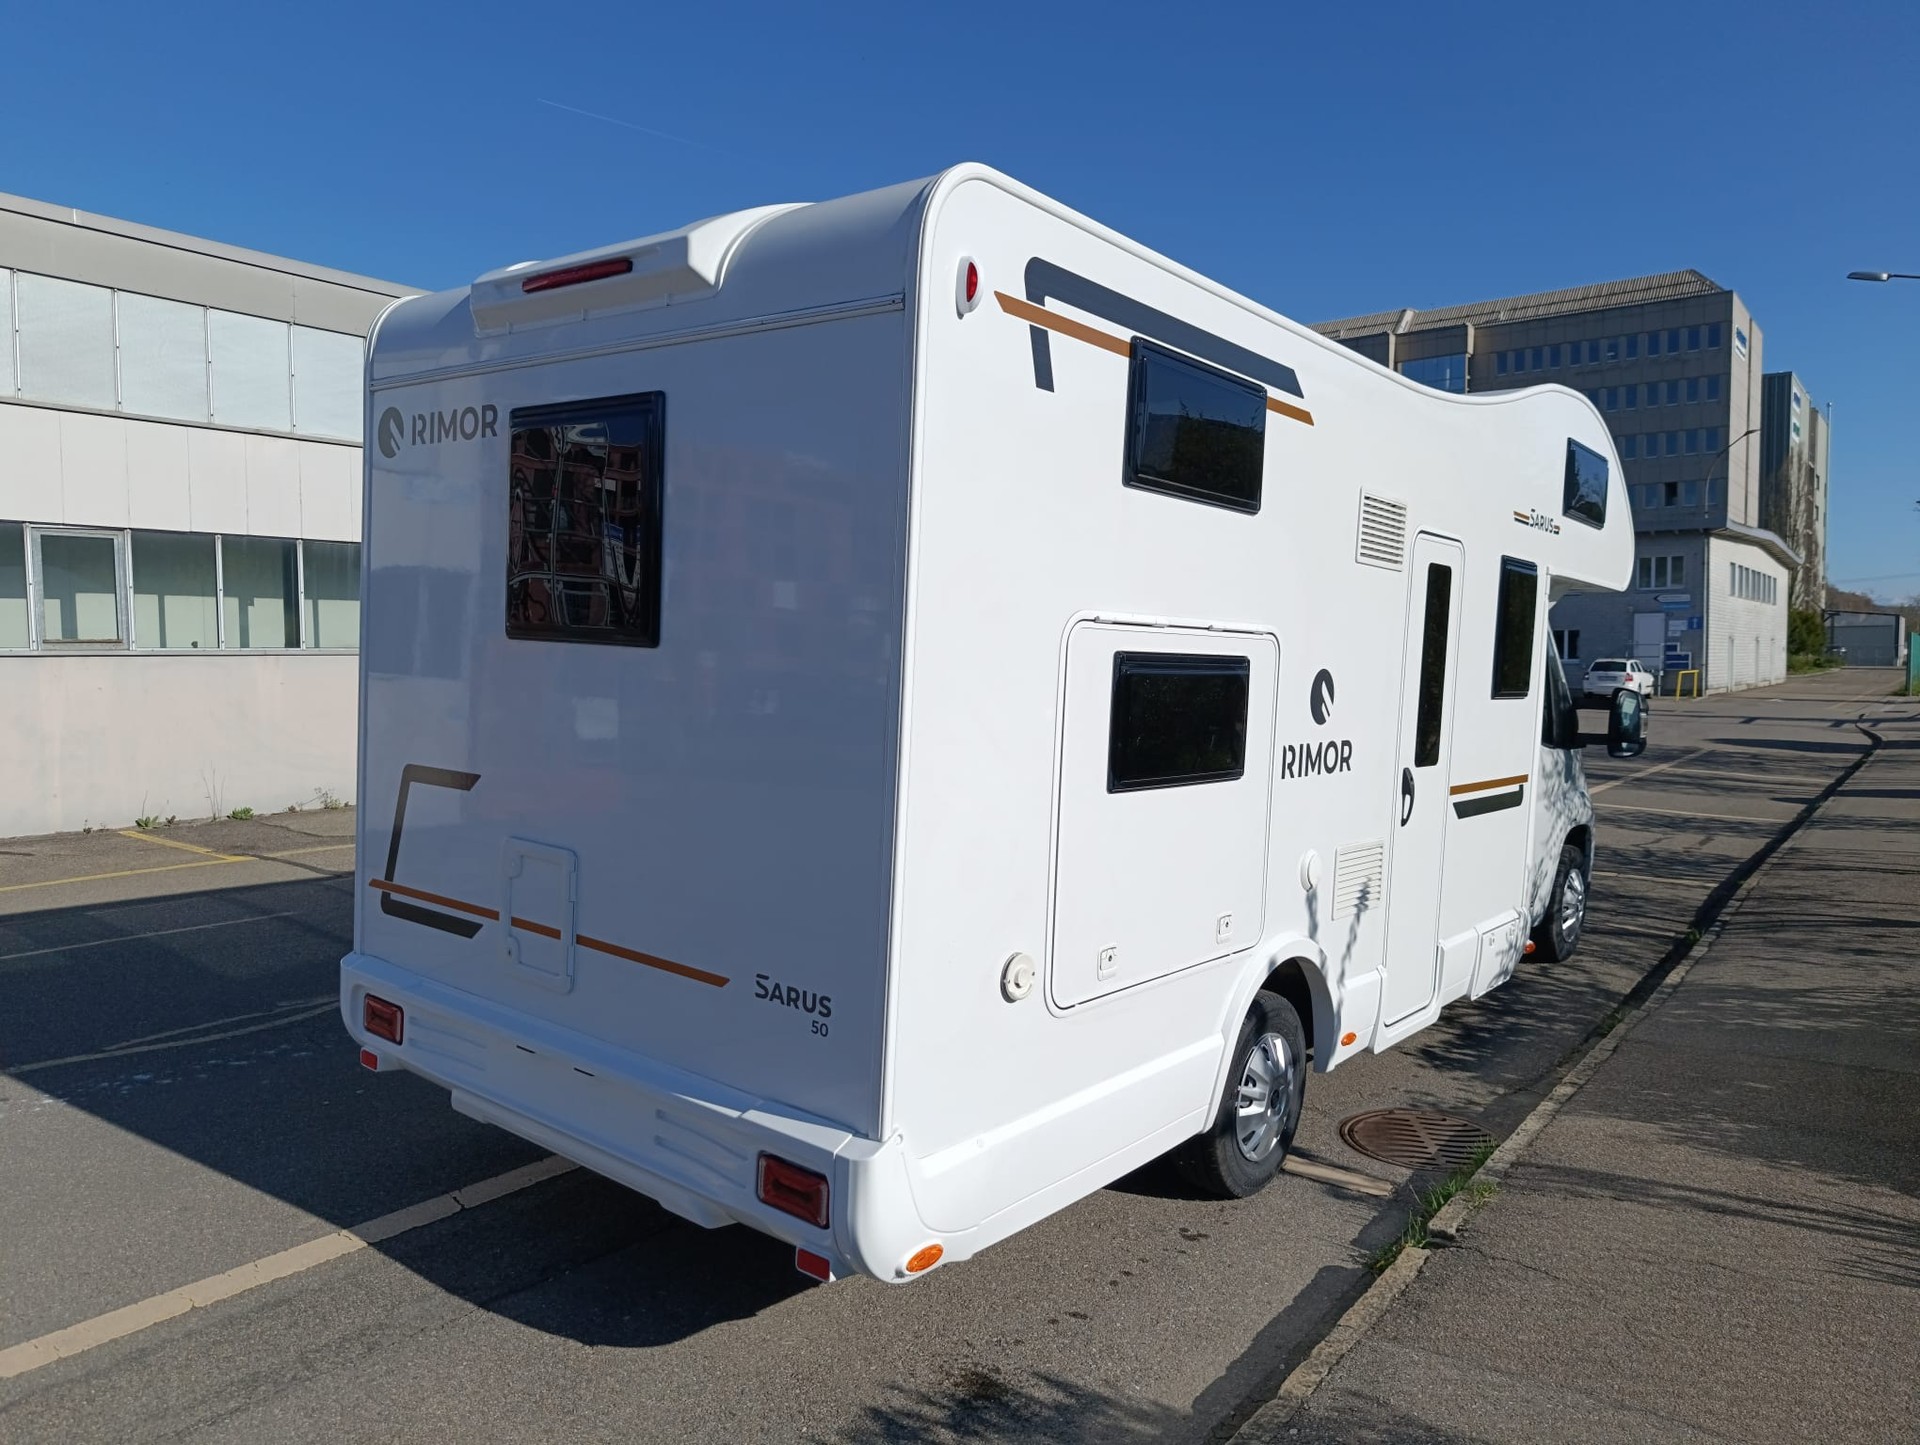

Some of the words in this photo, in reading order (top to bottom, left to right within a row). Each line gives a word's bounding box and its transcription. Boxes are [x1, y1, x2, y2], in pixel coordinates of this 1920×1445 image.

[411, 404, 498, 446] RIMOR
[1530, 508, 1554, 534] SARUS
[1281, 739, 1353, 780] RIMOR
[754, 973, 832, 1018] SARUS
[811, 1020, 829, 1037] 50
